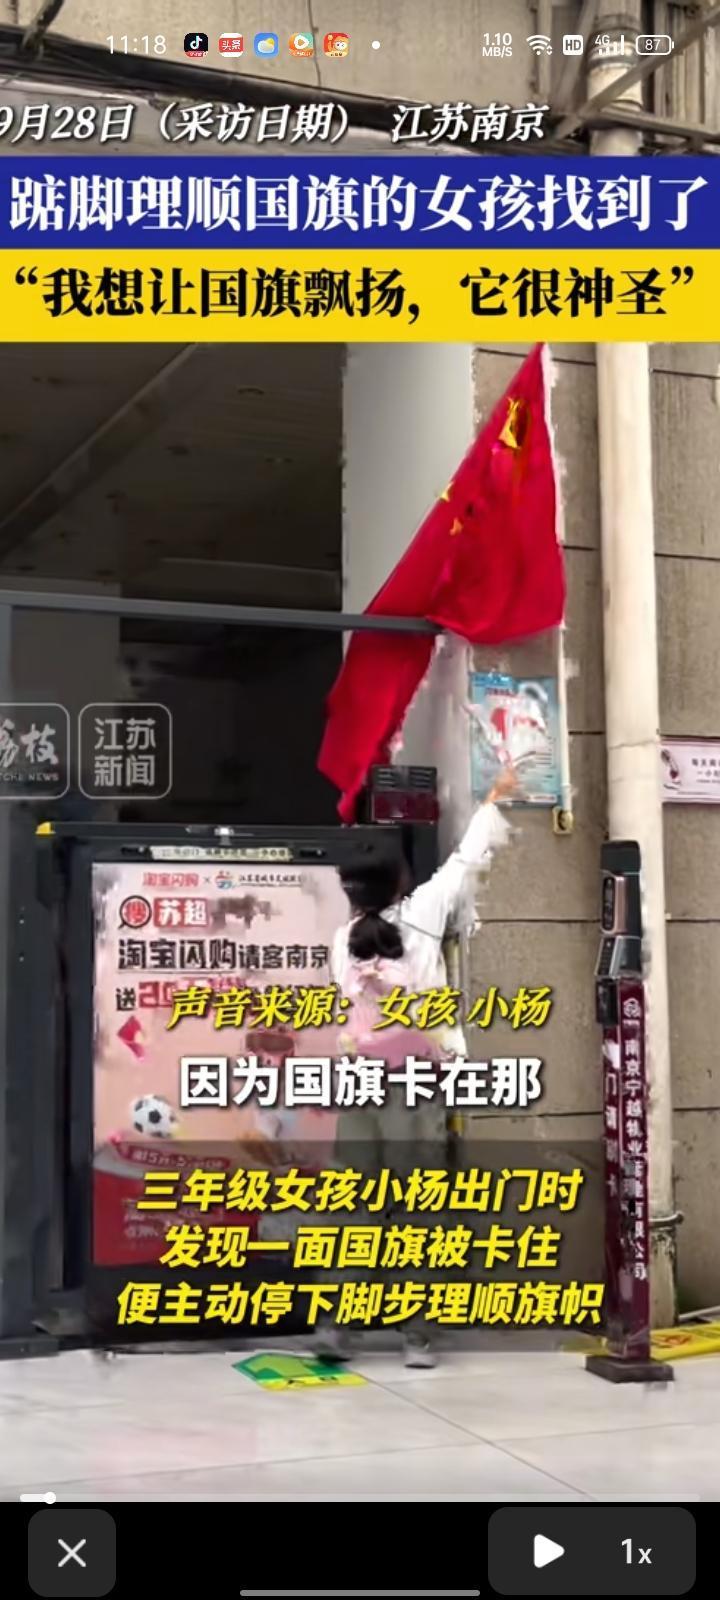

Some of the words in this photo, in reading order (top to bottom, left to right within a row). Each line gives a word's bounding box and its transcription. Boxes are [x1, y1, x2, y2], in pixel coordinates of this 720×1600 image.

[143, 872, 199, 888] 淘宝闪购
[158, 900, 207, 927] 苏超
